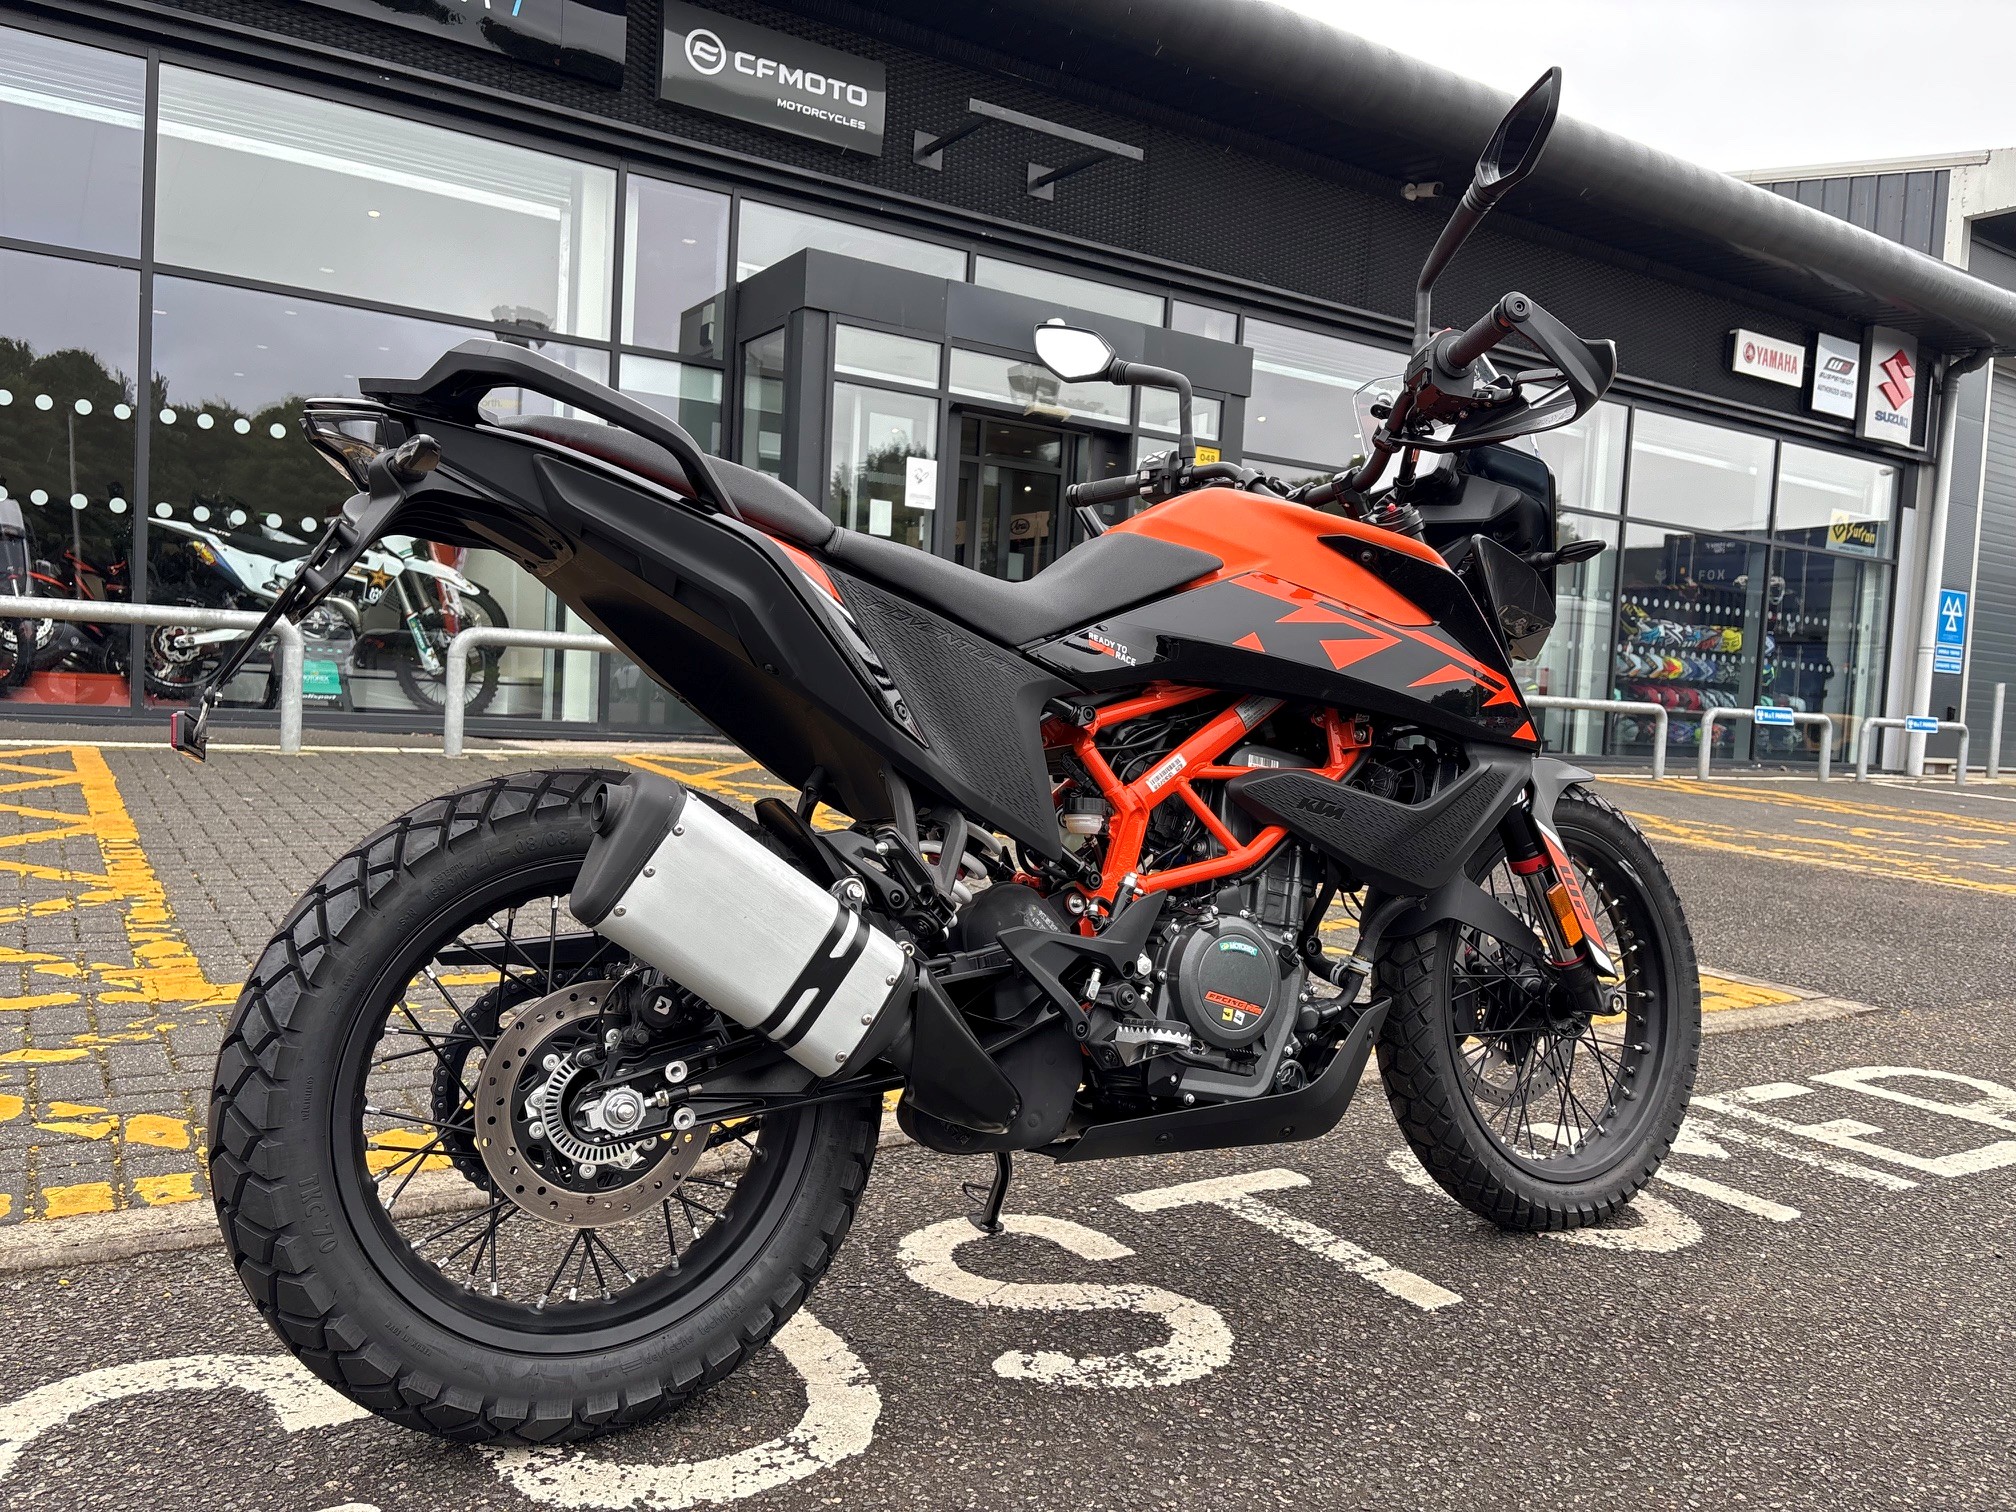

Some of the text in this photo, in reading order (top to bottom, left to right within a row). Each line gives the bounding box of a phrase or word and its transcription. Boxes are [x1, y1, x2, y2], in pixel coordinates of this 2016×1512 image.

[734, 51, 867, 107] CFMOTO
[777, 98, 866, 130] MOTORCYCLES
[1756, 346, 1798, 375] YAMAHA
[1874, 409, 1908, 429] SUZUKI
[1199, 453, 1216, 463] 048
[1698, 568, 1725, 581] FOX
[1088, 632, 1128, 654] READY TO
[1115, 651, 1136, 667] RACE
[1296, 797, 1346, 821] KTM
[297, 1172, 340, 1255] TKC 70
